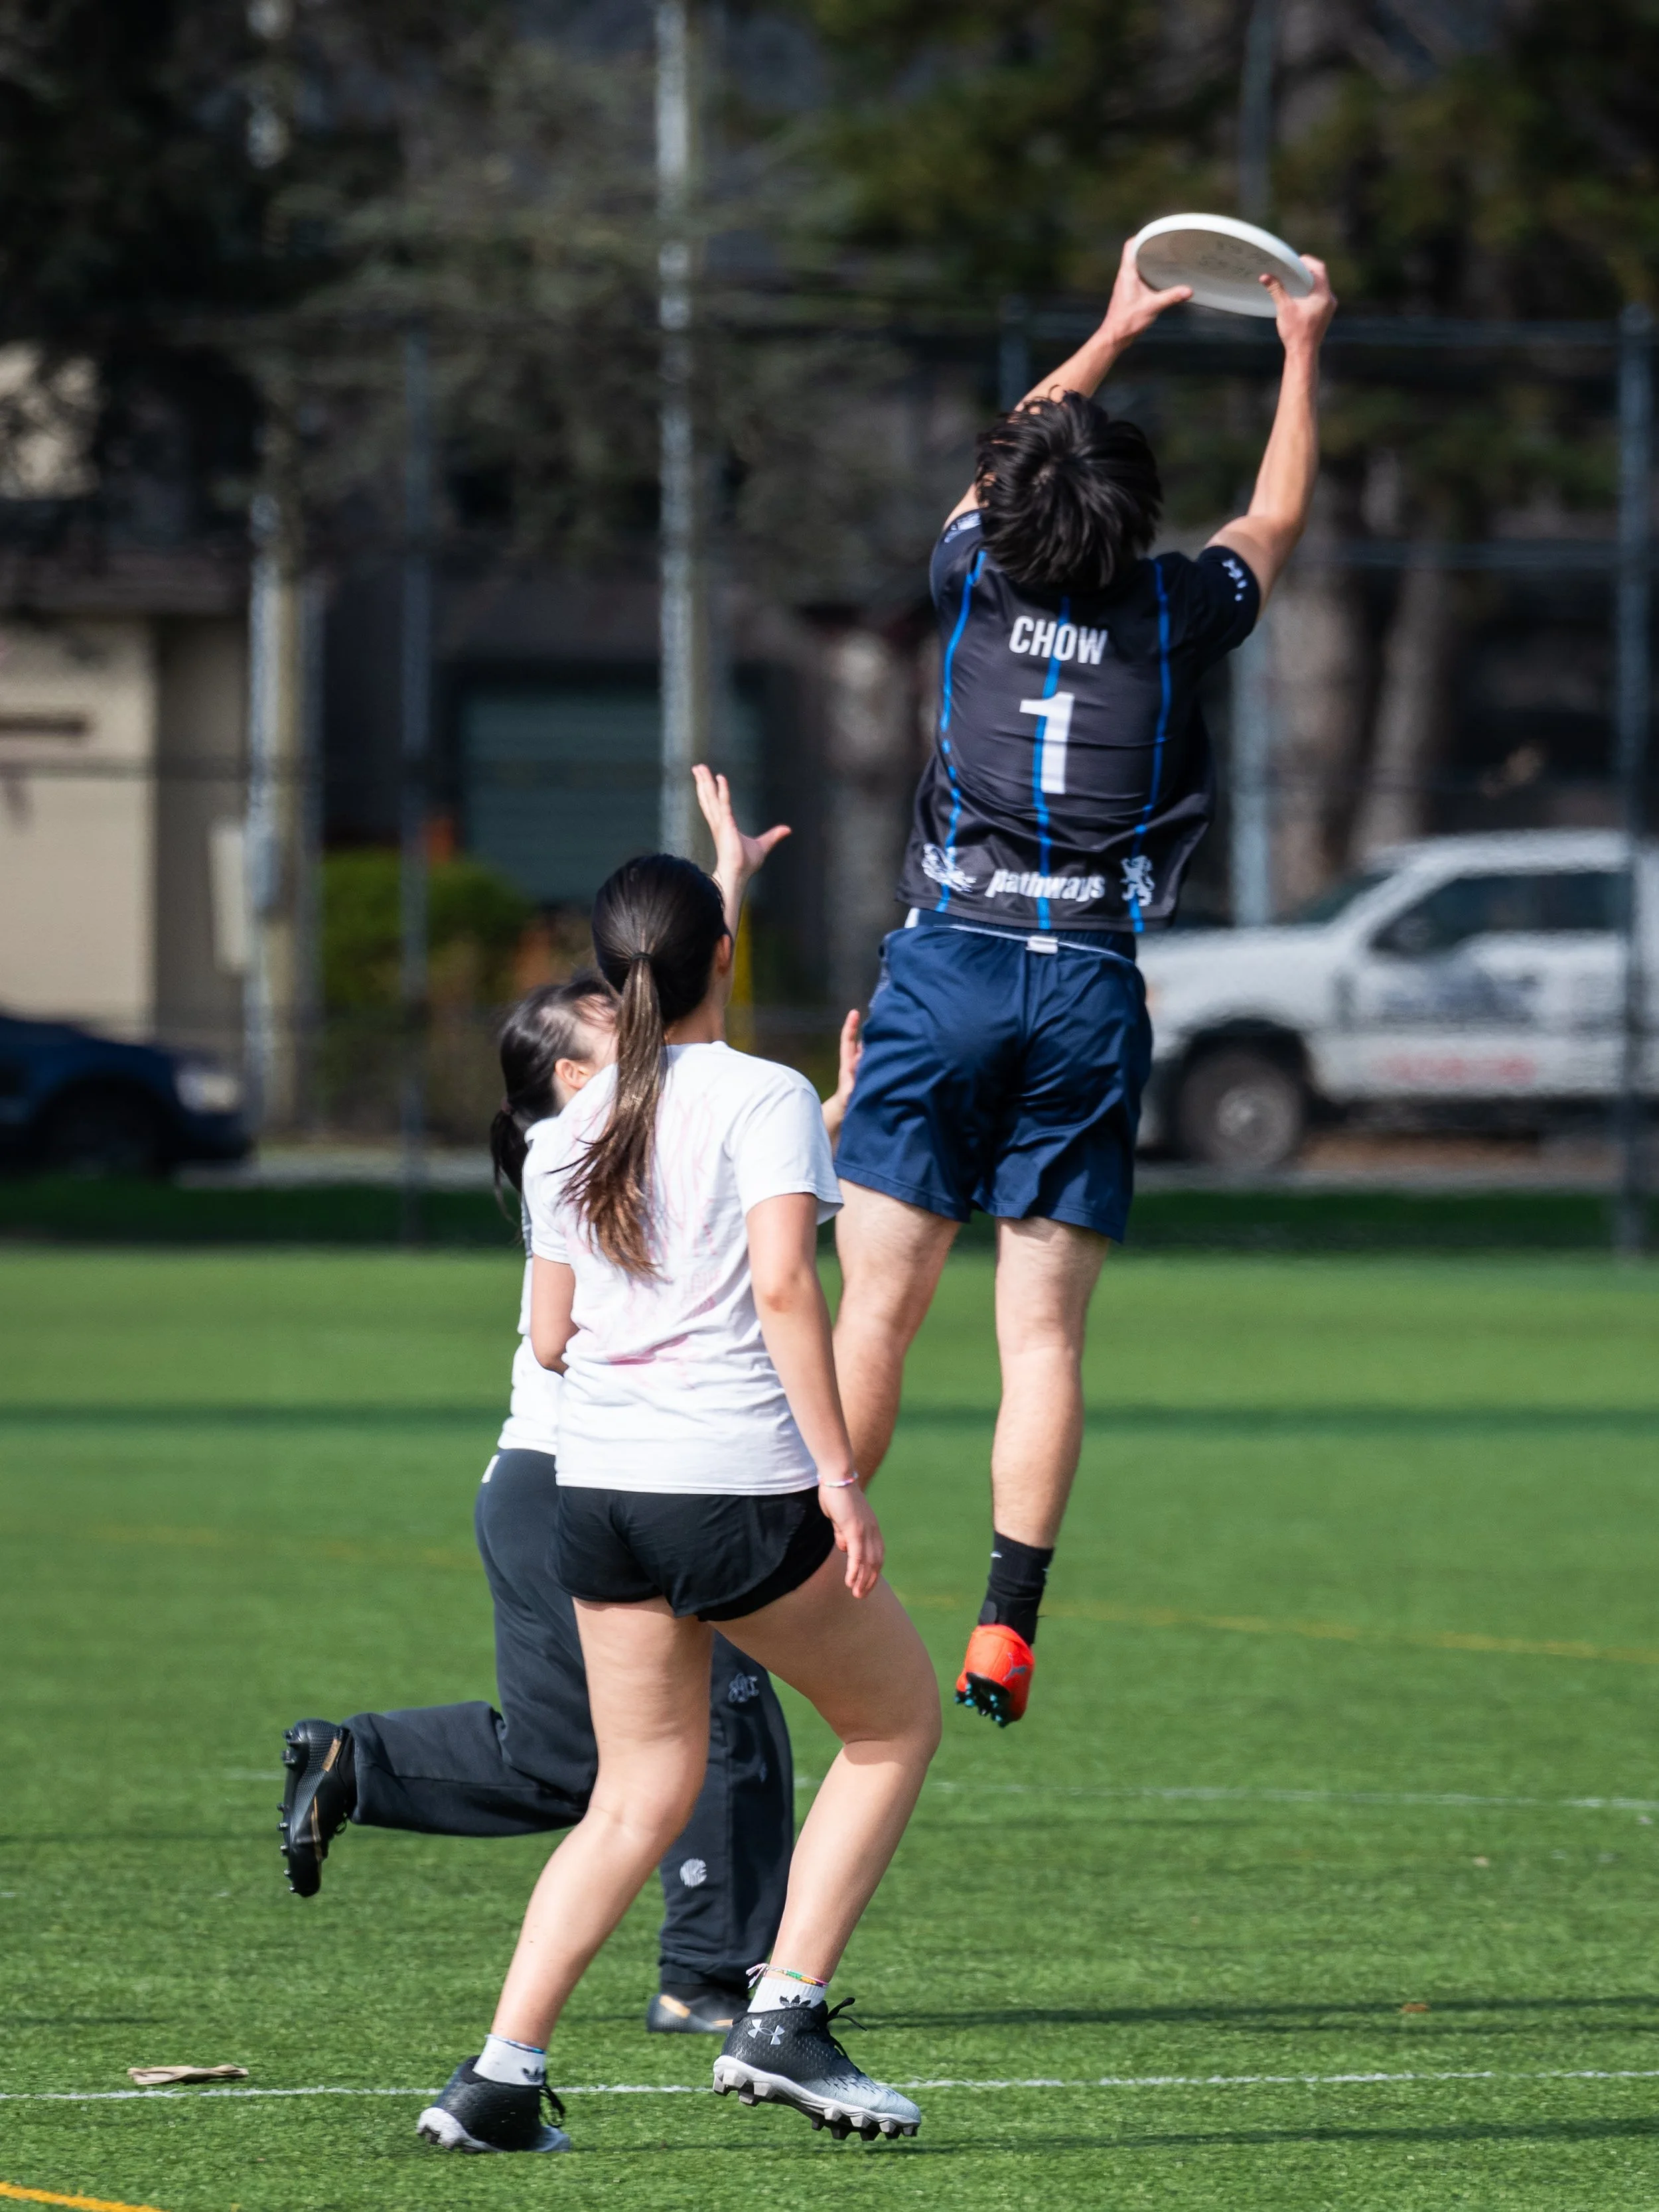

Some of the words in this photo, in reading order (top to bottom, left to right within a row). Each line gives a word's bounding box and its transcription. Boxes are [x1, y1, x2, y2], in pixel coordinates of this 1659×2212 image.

[1009, 616, 1108, 665] CHOW
[1020, 691, 1074, 794] 1
[985, 869, 1106, 902] pathways
